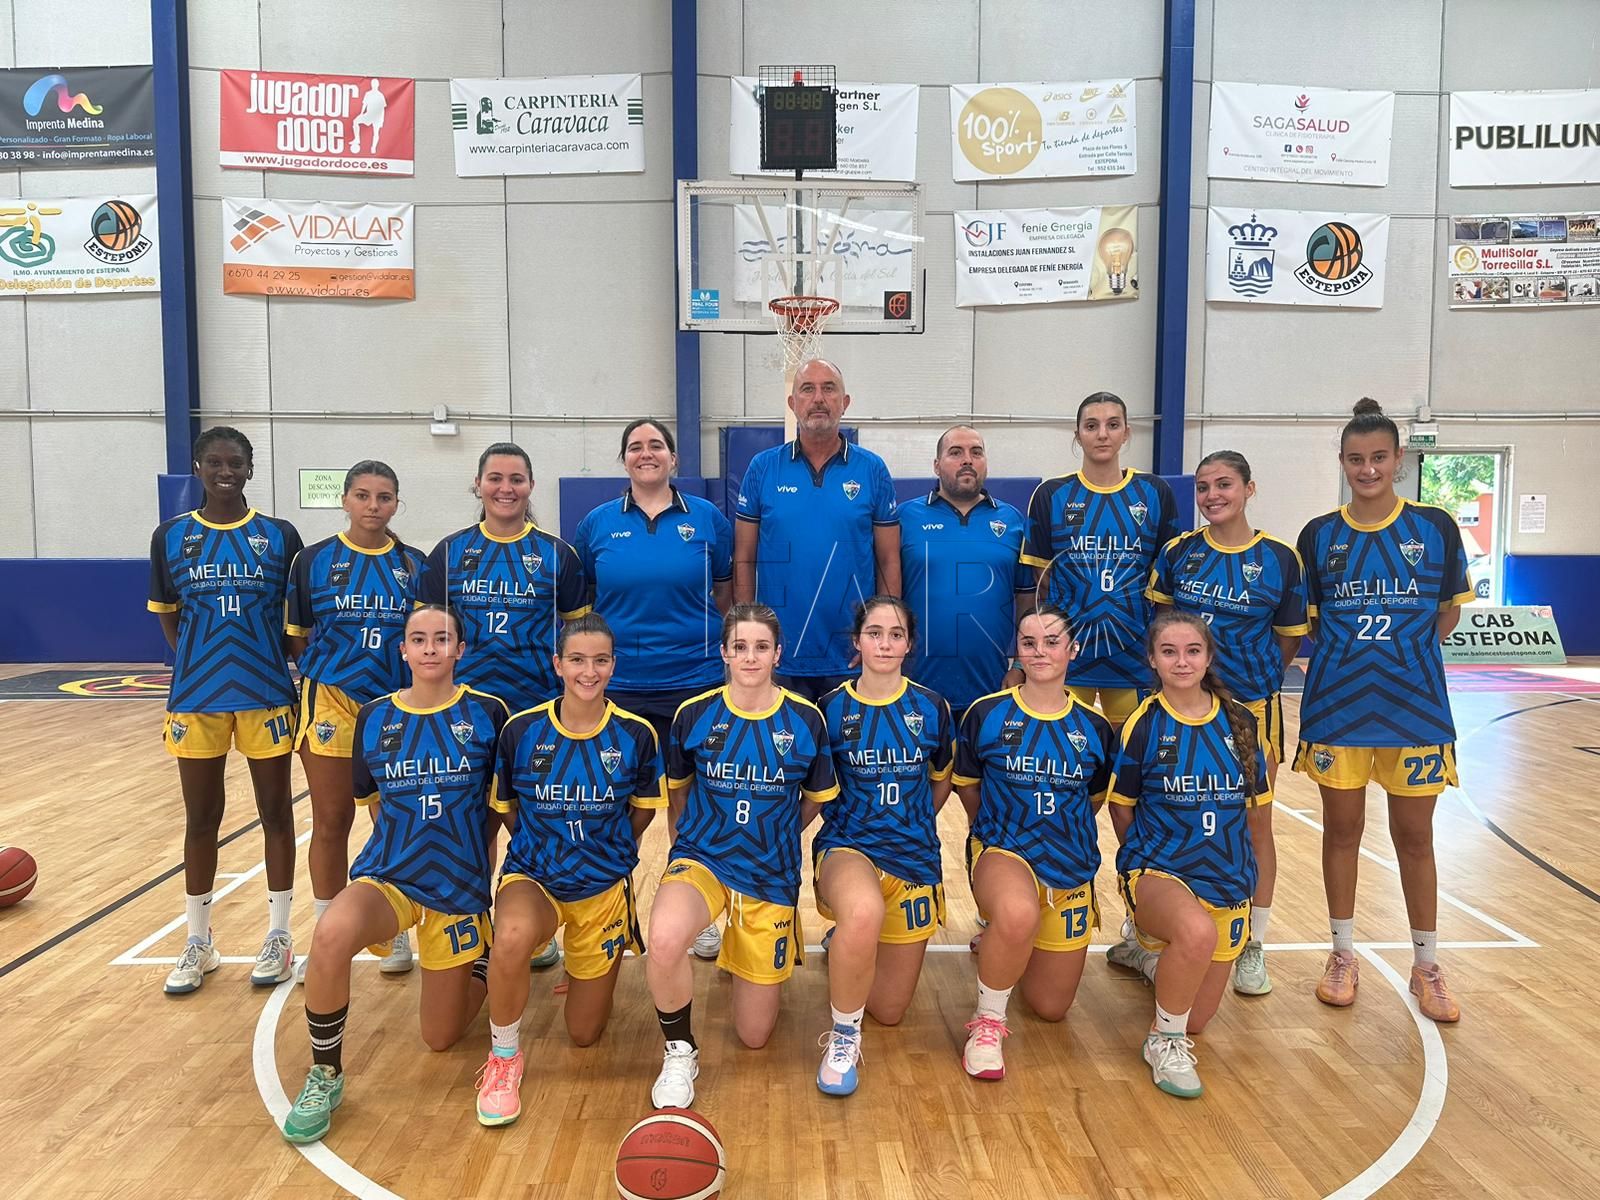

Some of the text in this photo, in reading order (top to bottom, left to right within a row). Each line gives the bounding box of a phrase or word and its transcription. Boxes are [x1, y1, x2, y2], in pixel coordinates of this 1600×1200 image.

[246, 73, 359, 118] jugador
[504, 94, 619, 110] CARPINTERIA
[832, 89, 880, 100] Partner
[863, 101, 881, 111] S.L.
[26, 118, 104, 132] Imprenta Medina
[517, 111, 610, 135] Caravaca
[963, 110, 1021, 143] 100%
[1253, 115, 1350, 133] SAGASALUD
[72, 135, 102, 143] Formato
[107, 134, 125, 142] Ropa
[126, 132, 153, 141] Laboral
[277, 117, 344, 154] doce
[1042, 126, 1123, 150] Tu tienda de deportes
[1455, 123, 1600, 150] PUBLILUN
[11, 149, 154, 160] 38 98 info@imprentamedina.es
[469, 141, 630, 156] www.carpinteriacaravaca.com
[981, 131, 1038, 163] sport
[244, 155, 388, 170] www.jugadordoce.es
[1243, 164, 1269, 173] CENTRO
[1269, 165, 1300, 174] INTEGRAL
[1314, 168, 1354, 177] MOVIMIENTO
[288, 214, 404, 241] VIDALAR
[1056, 233, 1086, 241] DELEGADA
[88, 241, 148, 262] ESTEPONA
[294, 245, 399, 258] Proyectos y Gestiones
[968, 249, 1015, 258] INSTALACIONES
[1015, 248, 1031, 256] JUAN
[1031, 247, 1067, 256] FERNANDEZ
[1481, 248, 1538, 259] MultiSolar
[34, 268, 85, 276] AYUNTAMIENTO
[969, 265, 997, 275] EMPRESA
[998, 264, 1030, 274] DELEGADA
[1030, 264, 1038, 272] DE
[1481, 260, 1533, 271] Torrecilla
[1535, 259, 1553, 269] S.L.
[75, 277, 92, 289] de
[95, 276, 156, 289] Deportes
[235, 269, 410, 282] 670 44 29 25 gestion@vidalar.es
[1299, 268, 1369, 293] ESTEPONA
[274, 284, 370, 297] www.vidalar.es
[777, 485, 798, 493] vive
[611, 530, 631, 539] vive
[1070, 535, 1142, 552] MELILLA
[188, 563, 264, 581] MELILLA
[1101, 569, 1114, 592] 6
[190, 581, 217, 589] CIUDAD
[233, 580, 265, 588] DEPORTE
[462, 579, 536, 597] MELILLA
[1180, 579, 1250, 604] MELILLA
[1334, 578, 1419, 599] MELILLA
[217, 595, 241, 617] 14
[335, 594, 407, 613] MELILLA
[1199, 596, 1213, 606] DEL
[1214, 600, 1250, 613] DEPORTE
[1381, 597, 1418, 605] DEPORTE
[486, 611, 509, 634] 12
[1356, 615, 1392, 641] 22
[1471, 614, 1515, 628] CAB
[360, 627, 382, 649] 16
[1441, 631, 1556, 647] ESTEPONA
[843, 713, 860, 722] vive
[265, 713, 292, 745] 14
[383, 723, 403, 731] vive
[848, 747, 923, 766] MELILLA
[385, 755, 471, 779] MELILLA
[706, 761, 785, 784] MELILLA
[1005, 755, 1083, 779] MELILLA
[1404, 753, 1444, 786] 22
[387, 779, 417, 788] CIUDAD
[418, 777, 433, 785] DEL
[707, 779, 785, 793] CIUDAD DEL DEPORTE
[1006, 773, 1033, 781] CIUDAD
[1163, 773, 1245, 793] MELILLA
[535, 784, 615, 802] MELILLA
[877, 783, 900, 806] 10
[1165, 793, 1195, 802] CIUDAD
[1197, 793, 1212, 801] DEL
[418, 794, 443, 820] 15
[536, 803, 561, 811] CIUDAD
[562, 803, 577, 811] DEL
[736, 800, 750, 825] 8
[1033, 792, 1056, 815] 13
[566, 820, 585, 842] 11
[1202, 811, 1216, 836] 9
[1066, 890, 1086, 901] vive
[900, 896, 932, 931] 10
[1060, 905, 1089, 939] 13
[443, 916, 480, 955] 15
[1229, 917, 1245, 948] 9
[773, 936, 788, 970] 8
